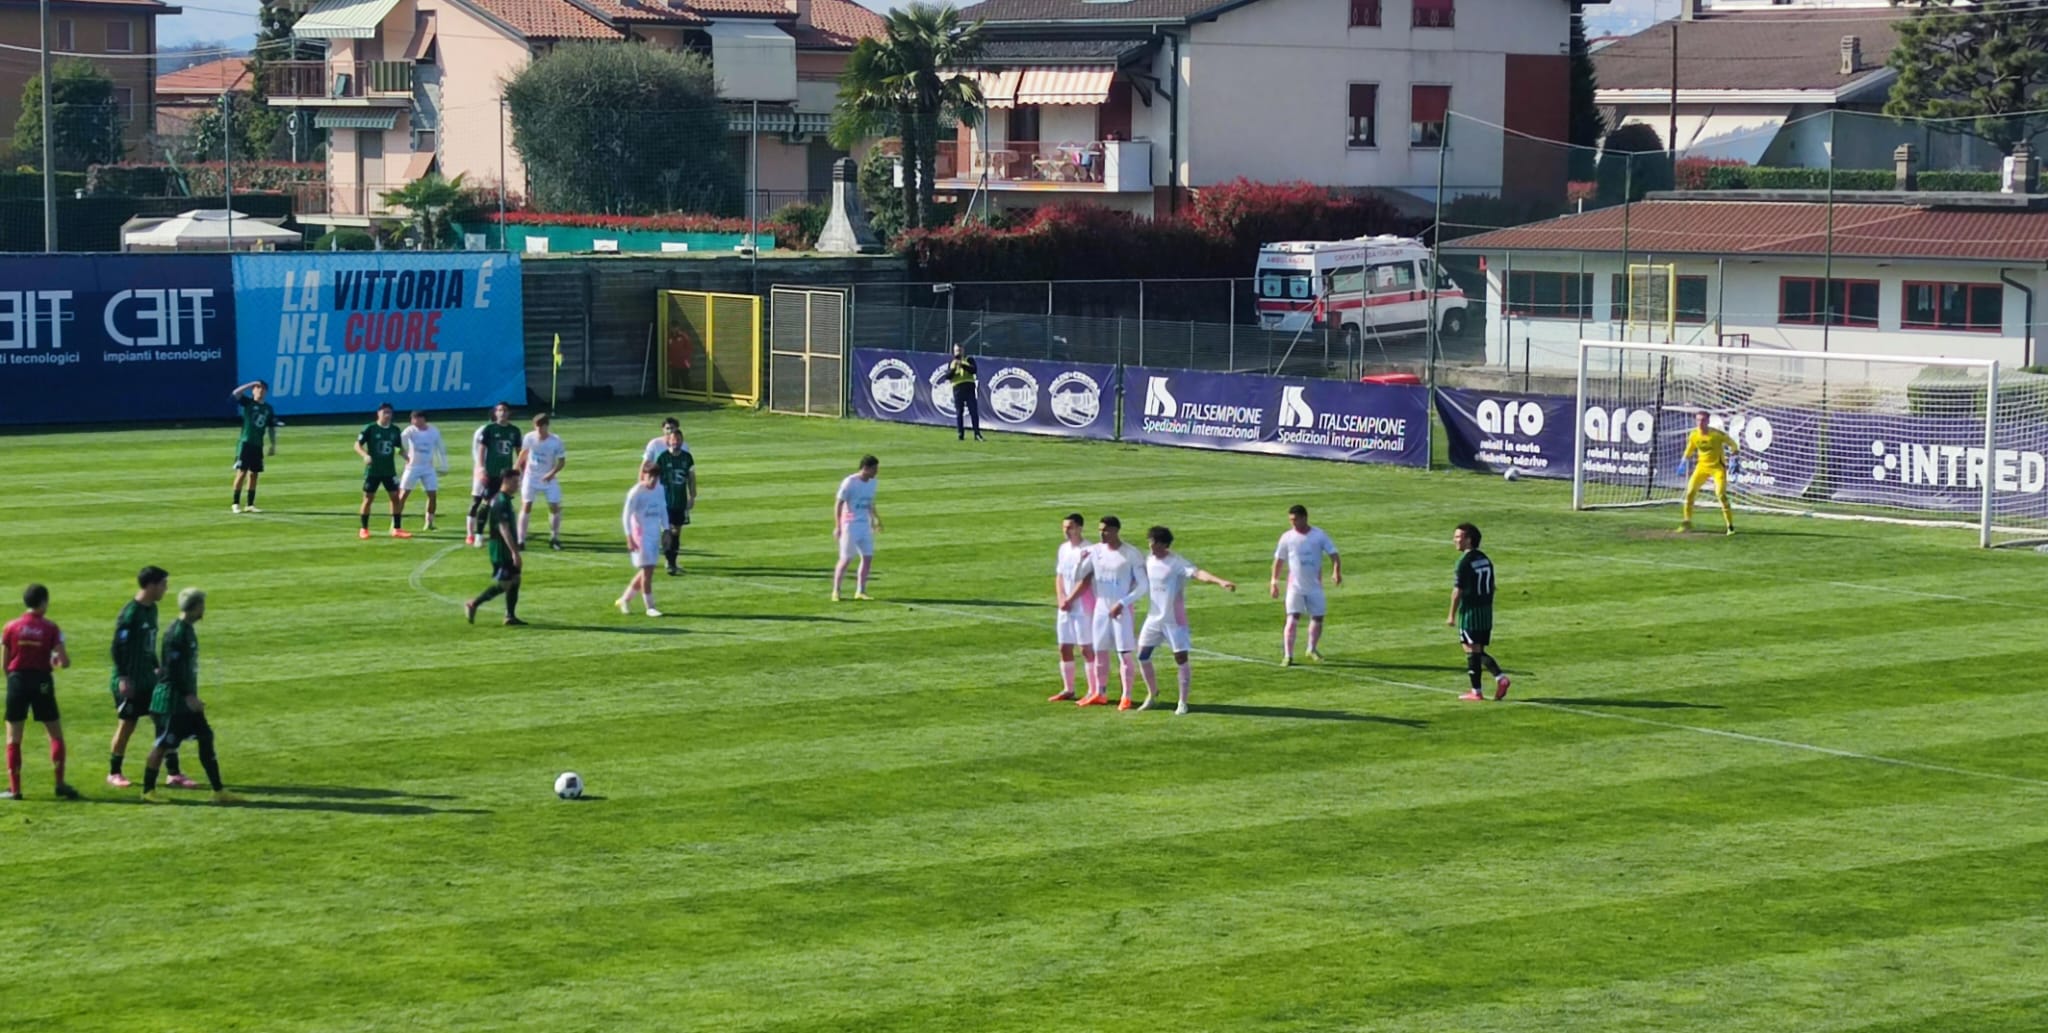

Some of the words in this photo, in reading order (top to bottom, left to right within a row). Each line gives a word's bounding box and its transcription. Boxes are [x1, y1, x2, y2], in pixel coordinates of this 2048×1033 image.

[282, 270, 320, 311] LA
[334, 269, 464, 311] VITTORIA
[277, 312, 332, 354] NEL
[344, 311, 442, 353] CUORE
[10, 352, 80, 366] tecnologici
[103, 350, 152, 362] impianti
[155, 348, 222, 362] tecnologici
[272, 355, 305, 397] DI
[314, 353, 366, 396] CHI
[374, 351, 471, 394] LOTTA.
[1181, 402, 1263, 424] ITALSEMPIONE
[1319, 412, 1406, 435] ITALSEMPIONE
[1477, 399, 1544, 436] aro
[1585, 406, 1654, 444] aro
[1143, 417, 1191, 434] Spedizioni
[1192, 422, 1260, 439] internazionali
[1278, 428, 1330, 445] Spedizioni
[1331, 432, 1404, 451] internazionali
[1900, 443, 2045, 493] INTRED
[1475, 566, 1491, 595] 77
